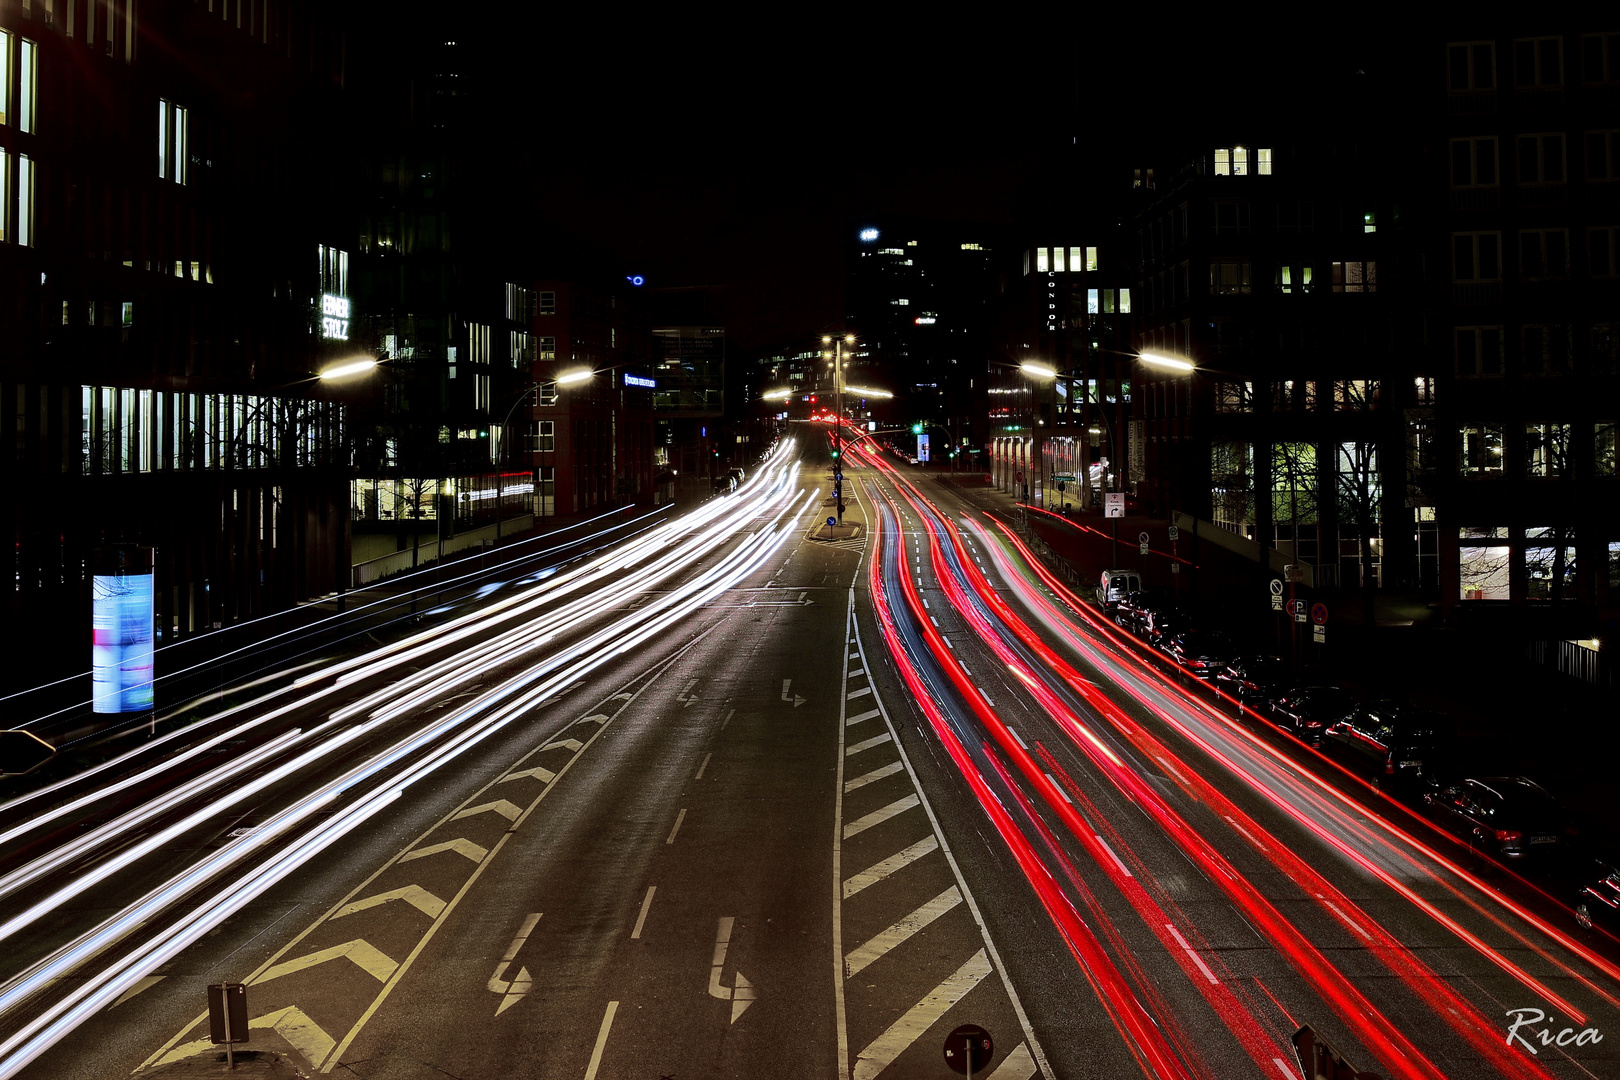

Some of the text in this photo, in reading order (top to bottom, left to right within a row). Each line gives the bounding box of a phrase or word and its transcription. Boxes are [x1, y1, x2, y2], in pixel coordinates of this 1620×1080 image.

[323, 294, 349, 318] EBNER
[1048, 271, 1056, 331] CONDOR
[323, 317, 349, 340] STOLZ
[1296, 601, 1303, 612] P
